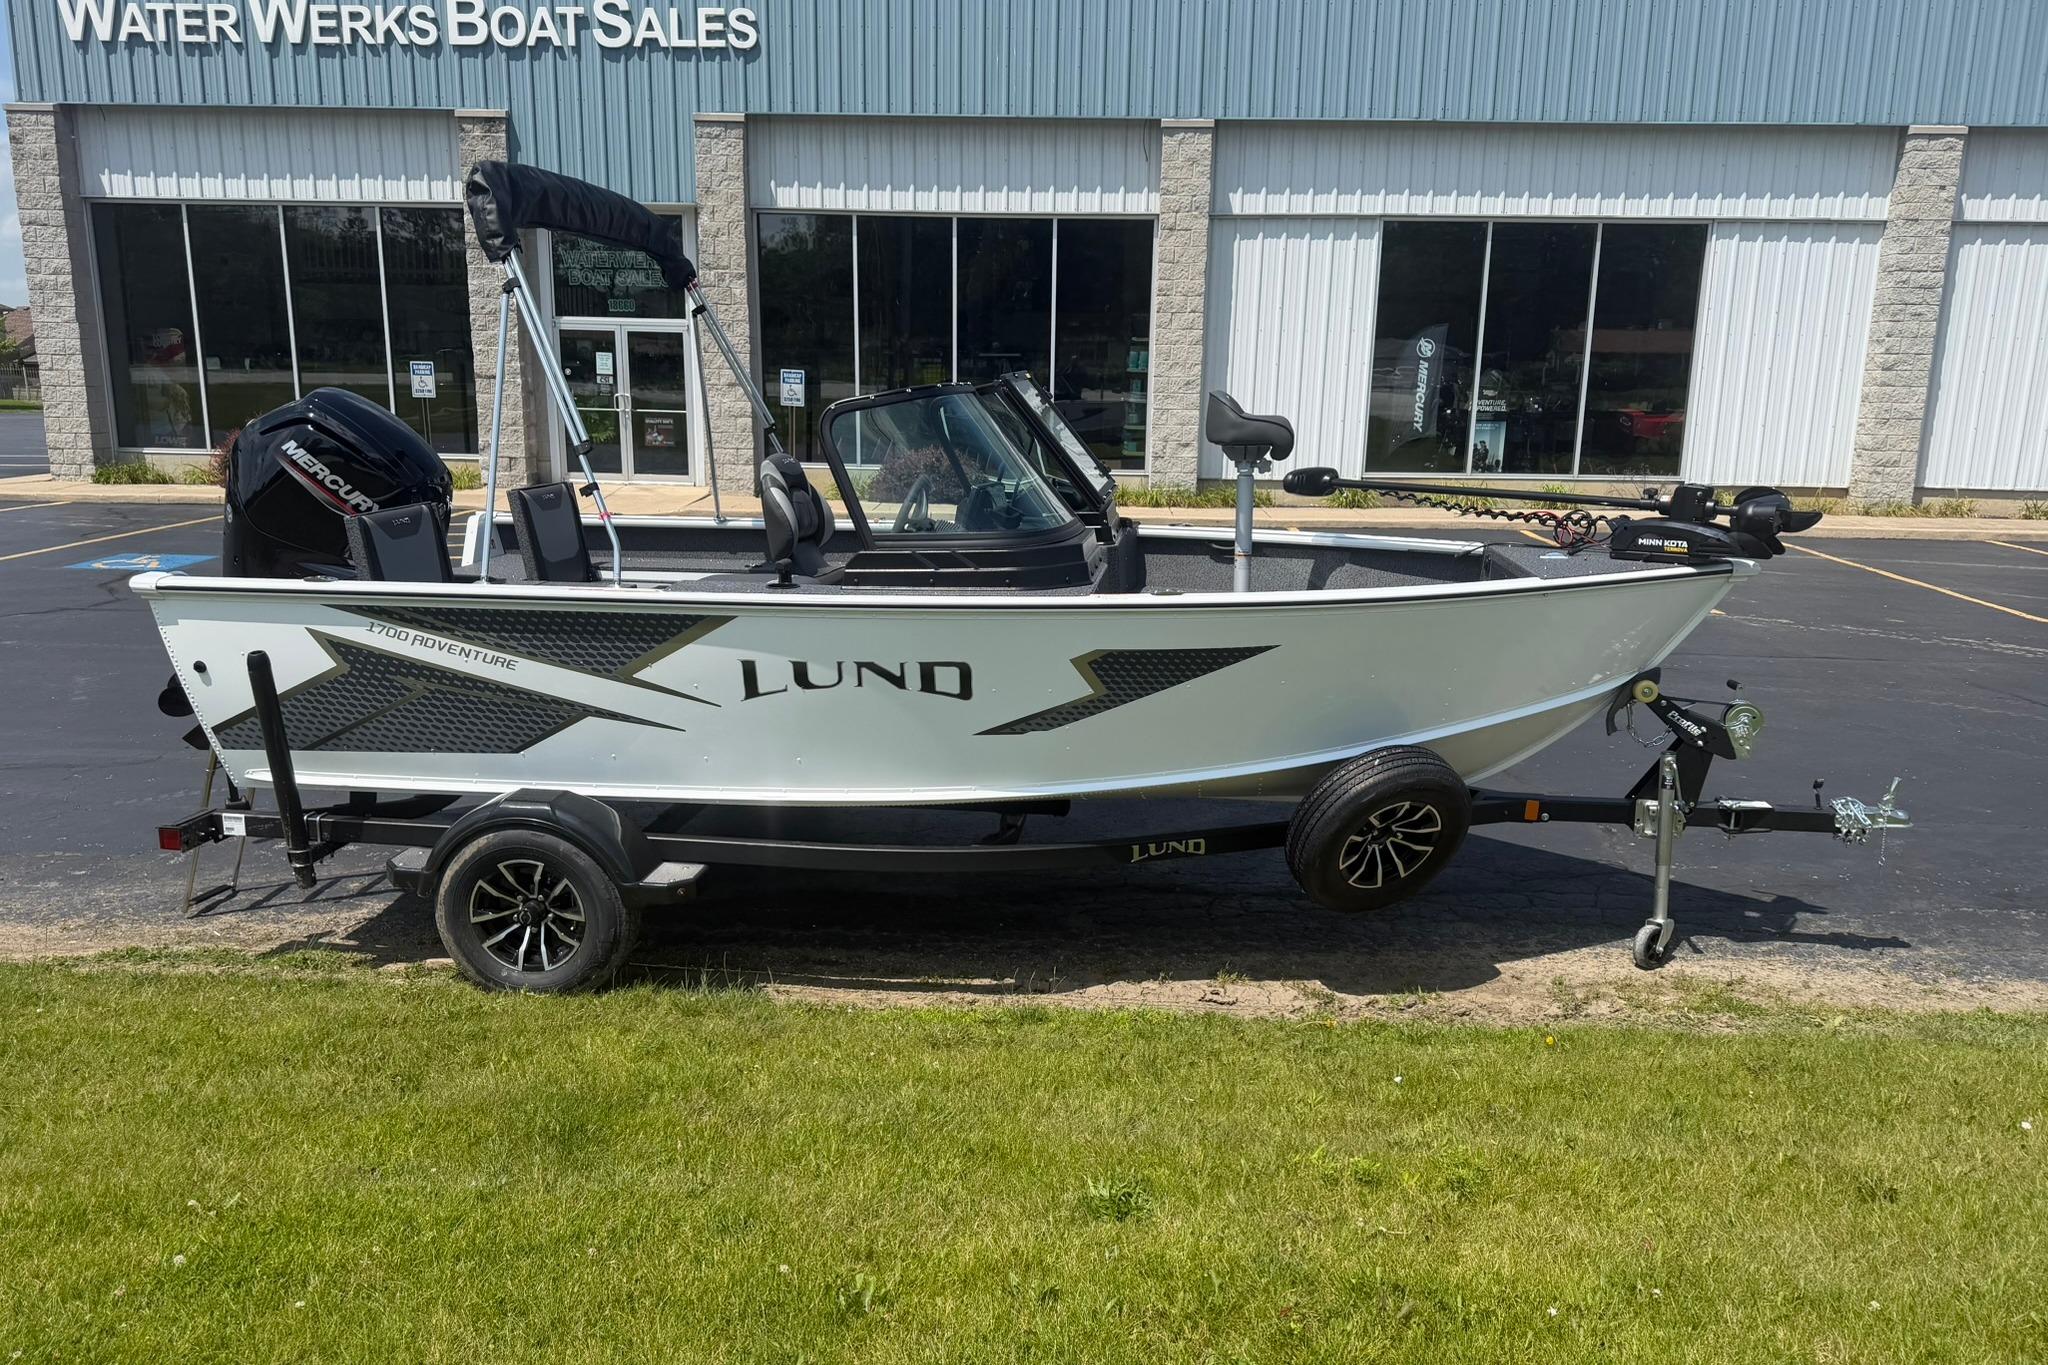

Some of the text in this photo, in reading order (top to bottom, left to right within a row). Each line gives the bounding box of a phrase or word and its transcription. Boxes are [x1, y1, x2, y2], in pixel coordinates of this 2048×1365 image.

[568, 269, 613, 285] BOAT
[1413, 360, 1429, 433] MERCURY
[1638, 538, 1689, 549] MINN KOTA
[365, 621, 519, 671] 1700 ADVENTURE
[737, 659, 974, 701] LUND
[1130, 838, 1206, 863] LUND
